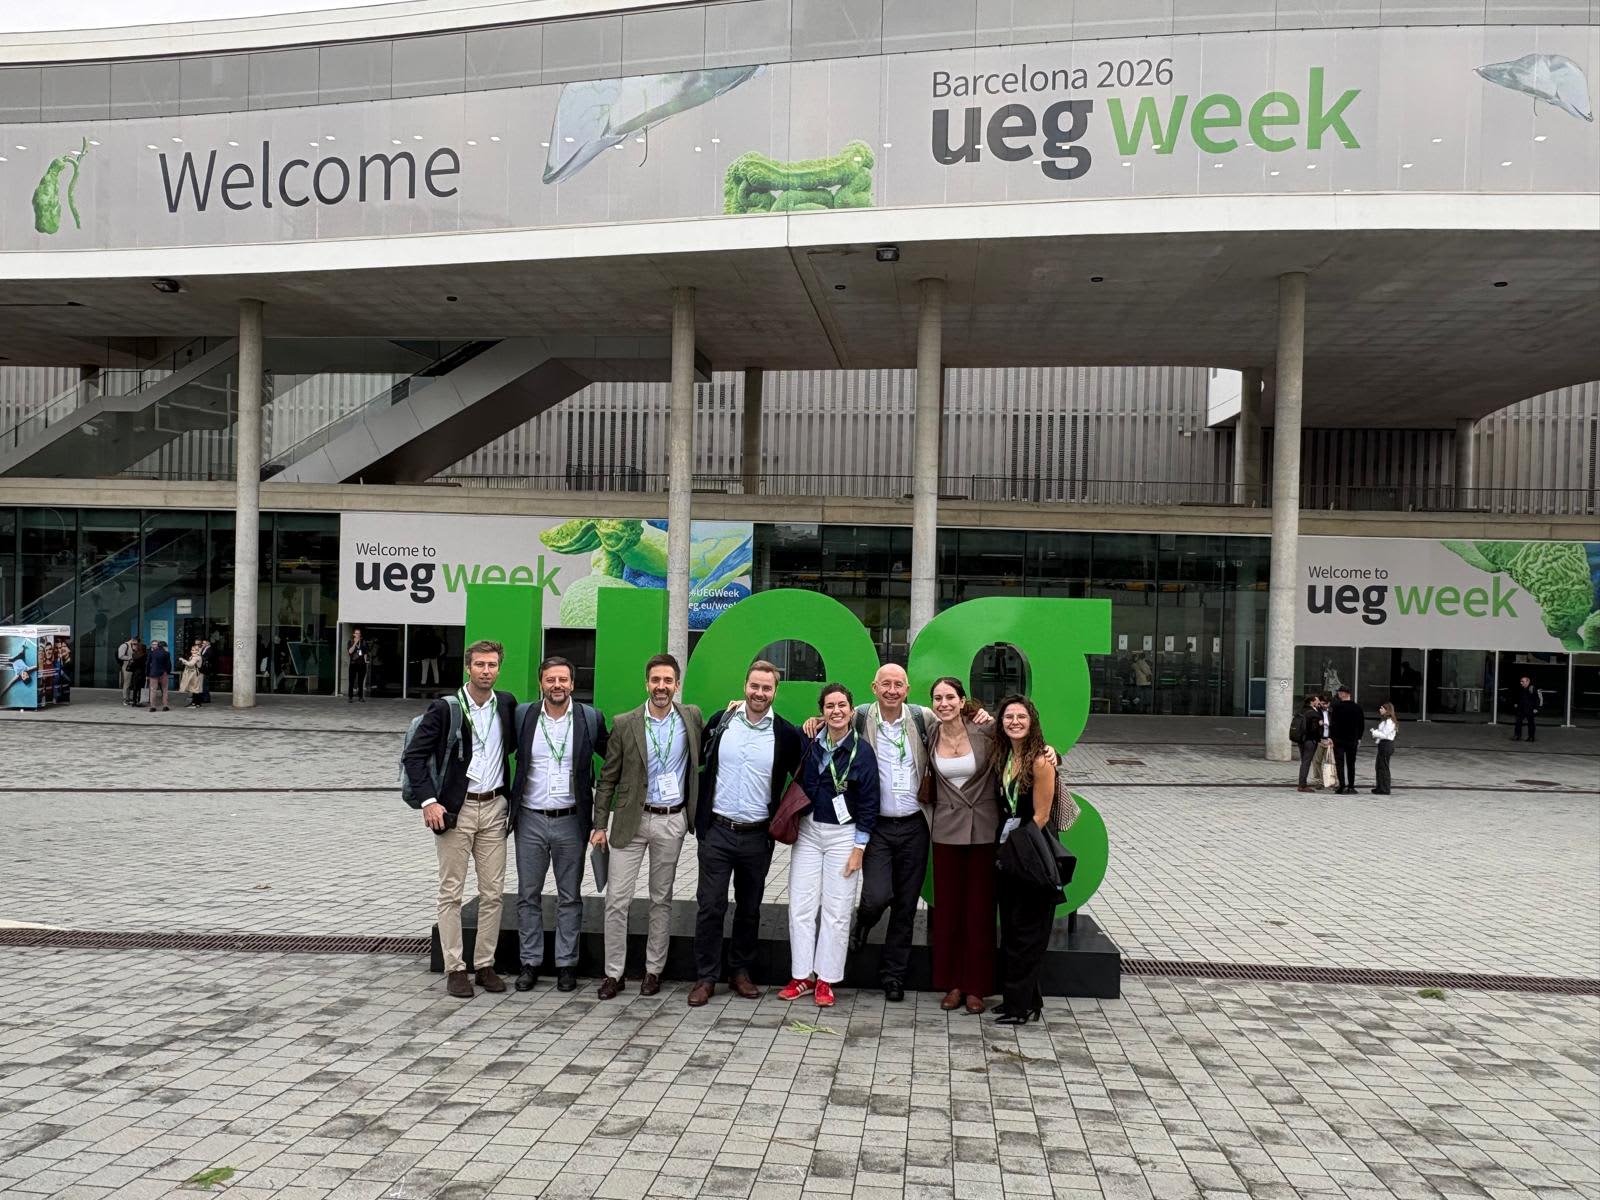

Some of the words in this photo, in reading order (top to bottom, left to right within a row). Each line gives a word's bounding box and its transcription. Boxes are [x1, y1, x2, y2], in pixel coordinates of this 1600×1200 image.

[933, 63, 1088, 98] Barcelona
[1097, 58, 1174, 86] 2026
[932, 99, 1093, 181] ueg
[1107, 67, 1361, 155] week
[158, 140, 461, 213] Welcome
[356, 543, 419, 557] Welcome
[422, 545, 436, 558] to
[1308, 565, 1371, 579] Welcome
[1375, 567, 1389, 579] to
[355, 562, 436, 604] ueg
[441, 555, 562, 596] week
[1307, 584, 1388, 625] ueg
[1394, 576, 1519, 618] week
[688, 601, 737, 611] eg.eu/wee
